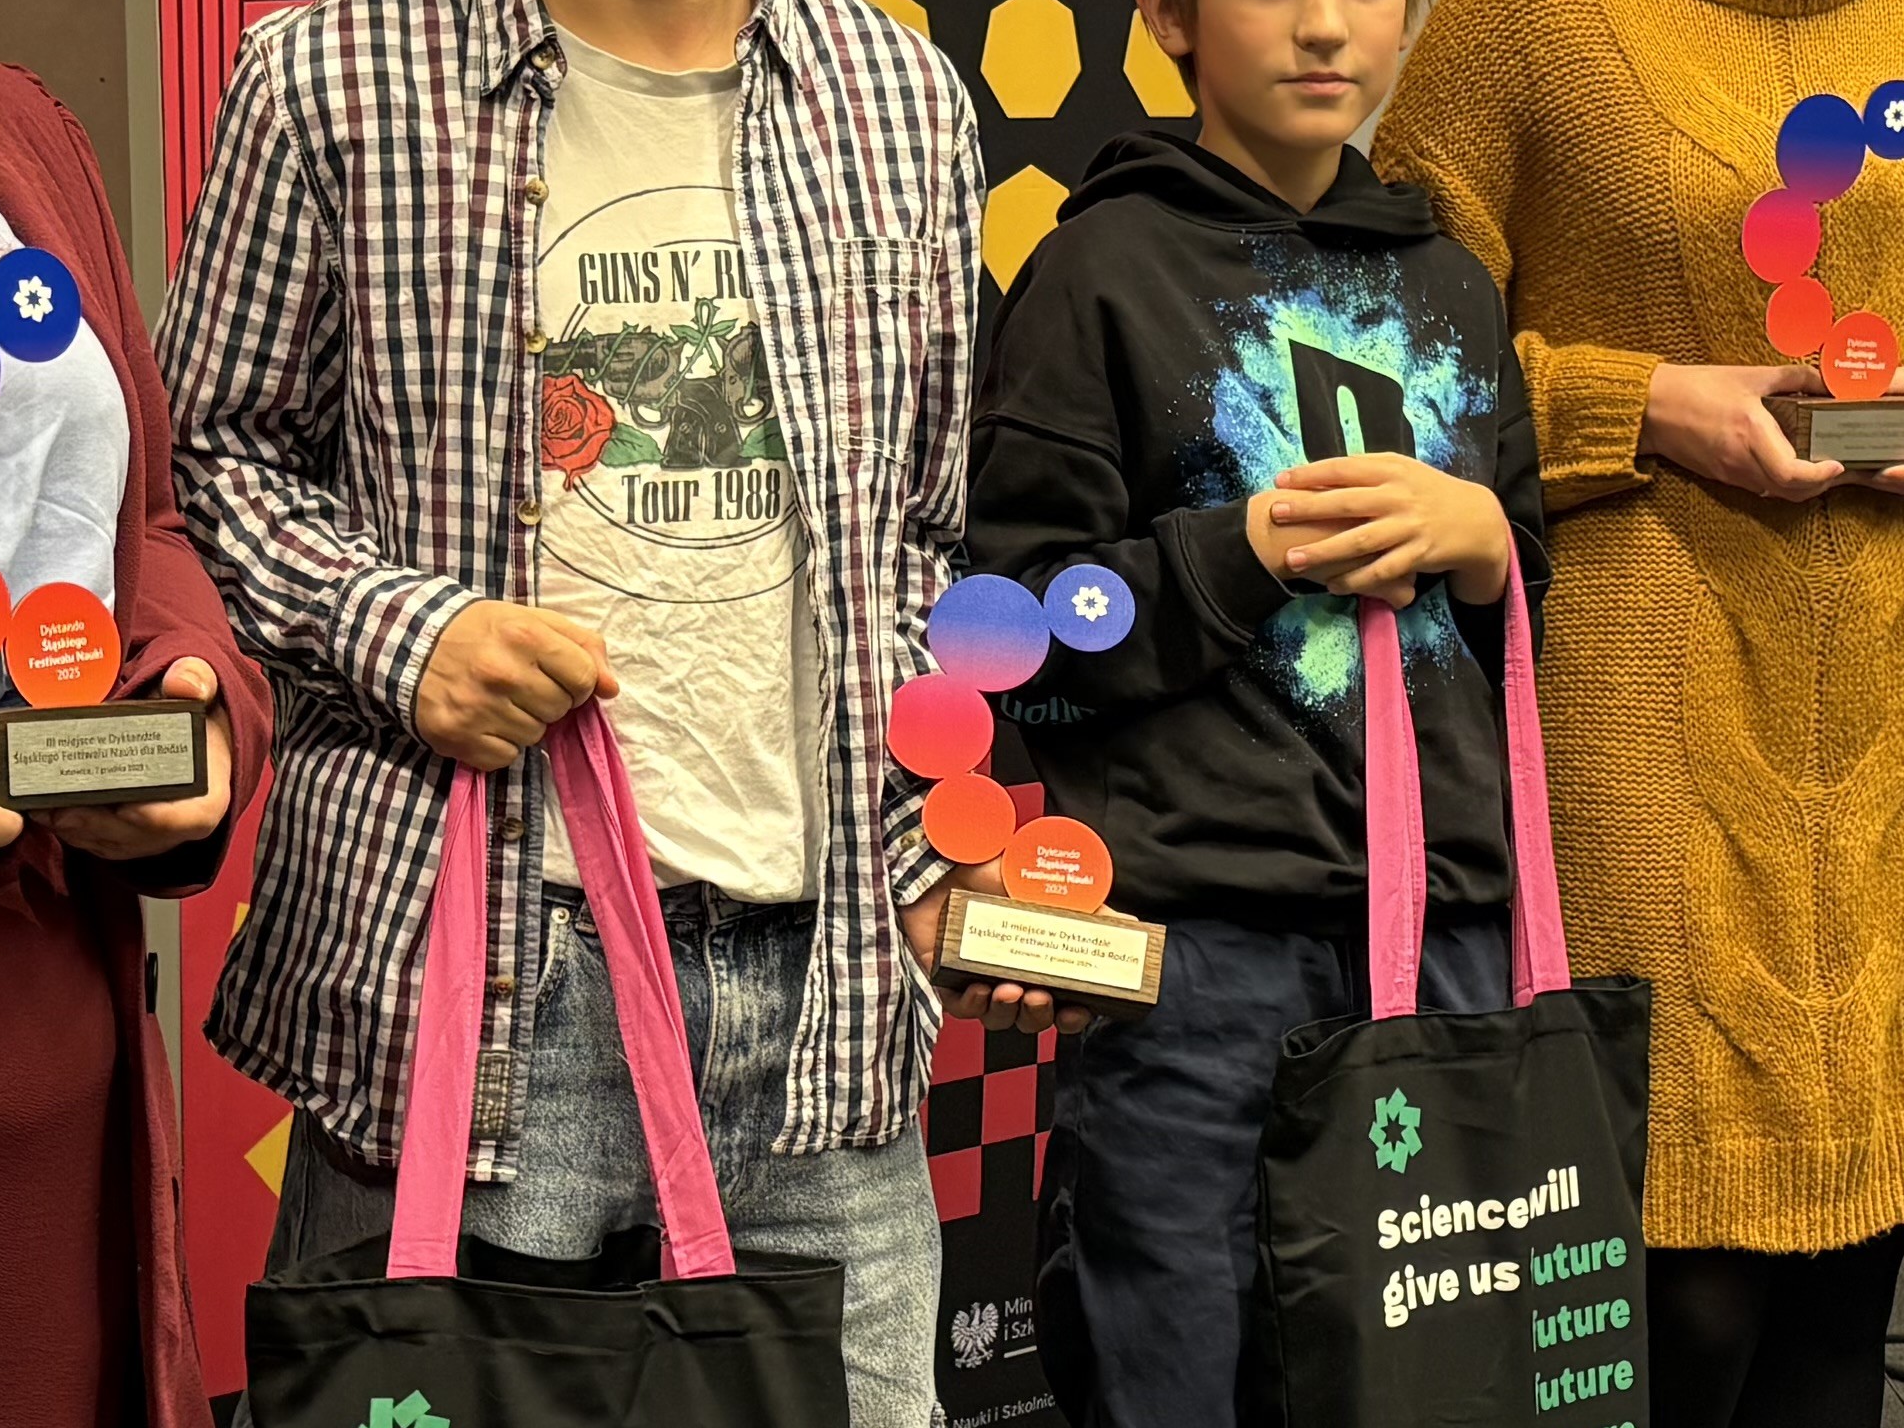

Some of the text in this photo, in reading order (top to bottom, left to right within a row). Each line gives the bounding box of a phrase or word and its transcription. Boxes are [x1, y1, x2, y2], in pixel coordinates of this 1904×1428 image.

[578, 251, 661, 304] GUNS
[622, 468, 782, 525] Tour 1988
[1378, 1166, 1581, 1250] Science will
[1382, 1237, 1628, 1328] give us uture
[994, 1406, 999, 1421] i
